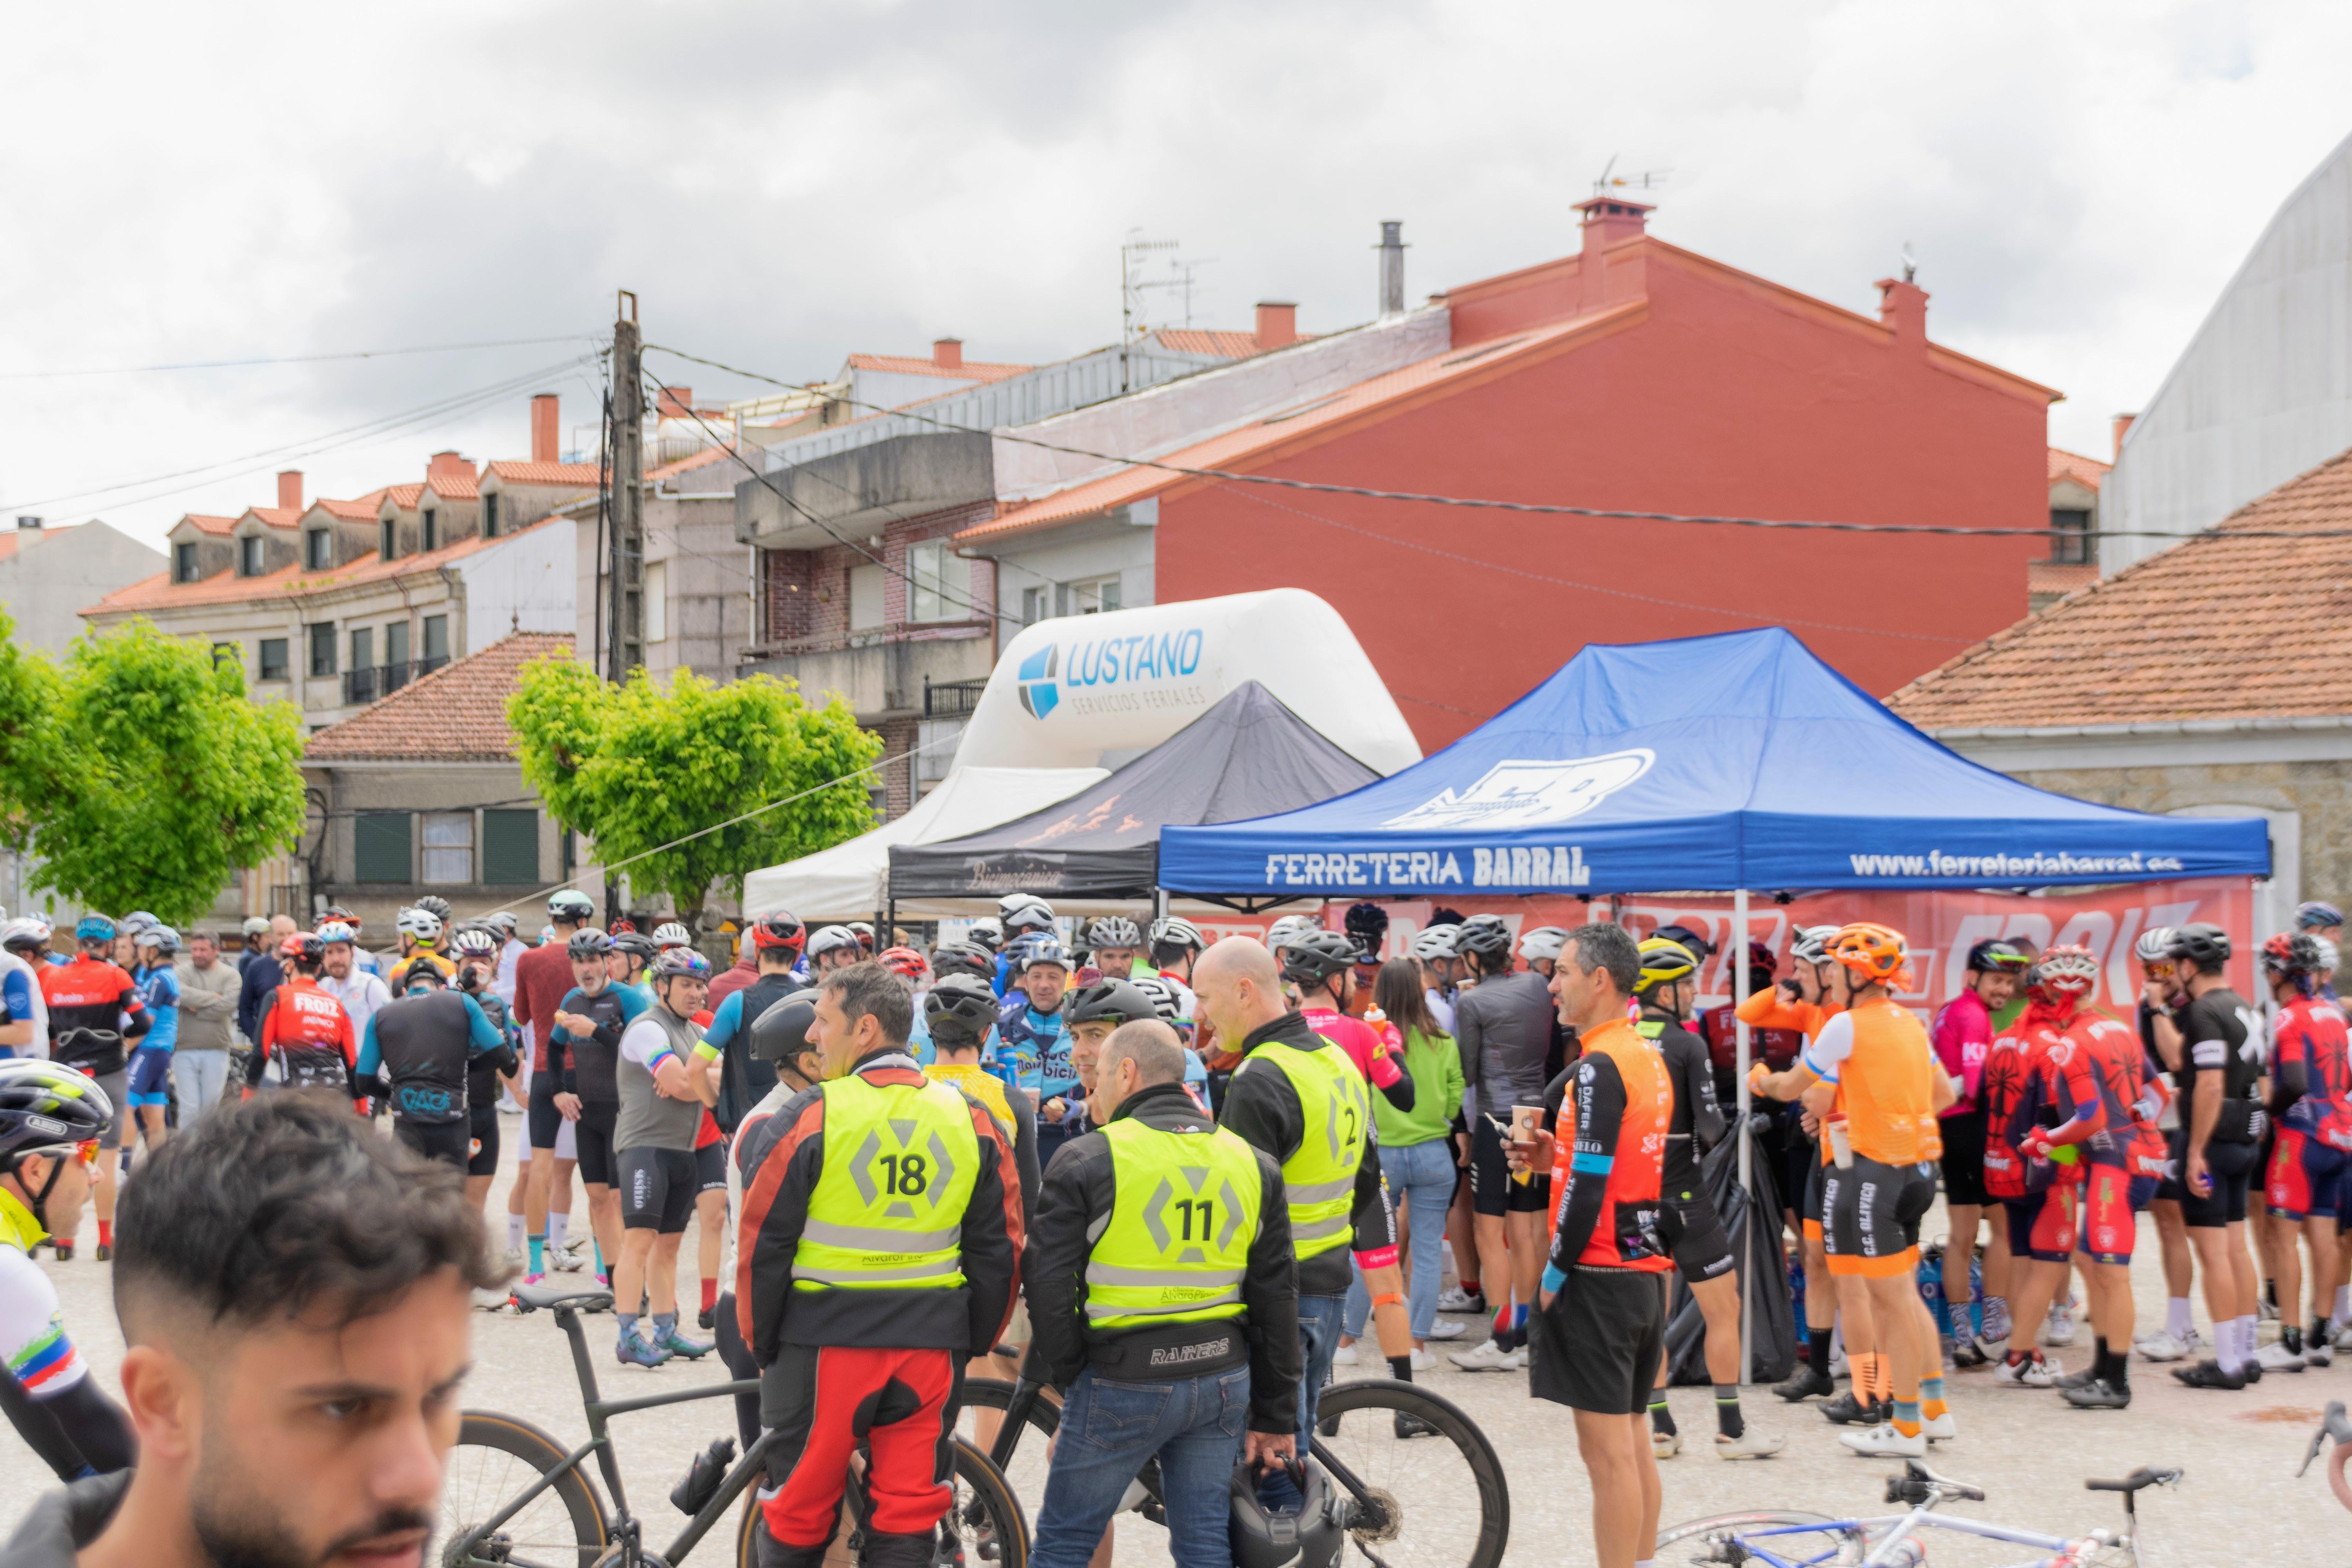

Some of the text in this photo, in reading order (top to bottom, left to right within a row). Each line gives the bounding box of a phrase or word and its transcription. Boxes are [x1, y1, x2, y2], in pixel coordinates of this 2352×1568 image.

[1067, 628, 1203, 686] LUSTAND
[1072, 686, 1205, 715] SERVICIOS FERIALES
[1265, 846, 1590, 886] FERRETERIA BARRAL
[294, 997, 340, 1018] FROIZ
[31, 1118, 64, 1133] ABUS
[1345, 1107, 1355, 1146] 2
[1580, 1086, 1593, 1129] DAFER
[880, 1154, 926, 1196] 18
[1175, 1199, 1212, 1241] 11
[1823, 1178, 1838, 1254] C.C. OLIVICO
[1859, 1182, 1876, 1256] C.C. OLIVICO
